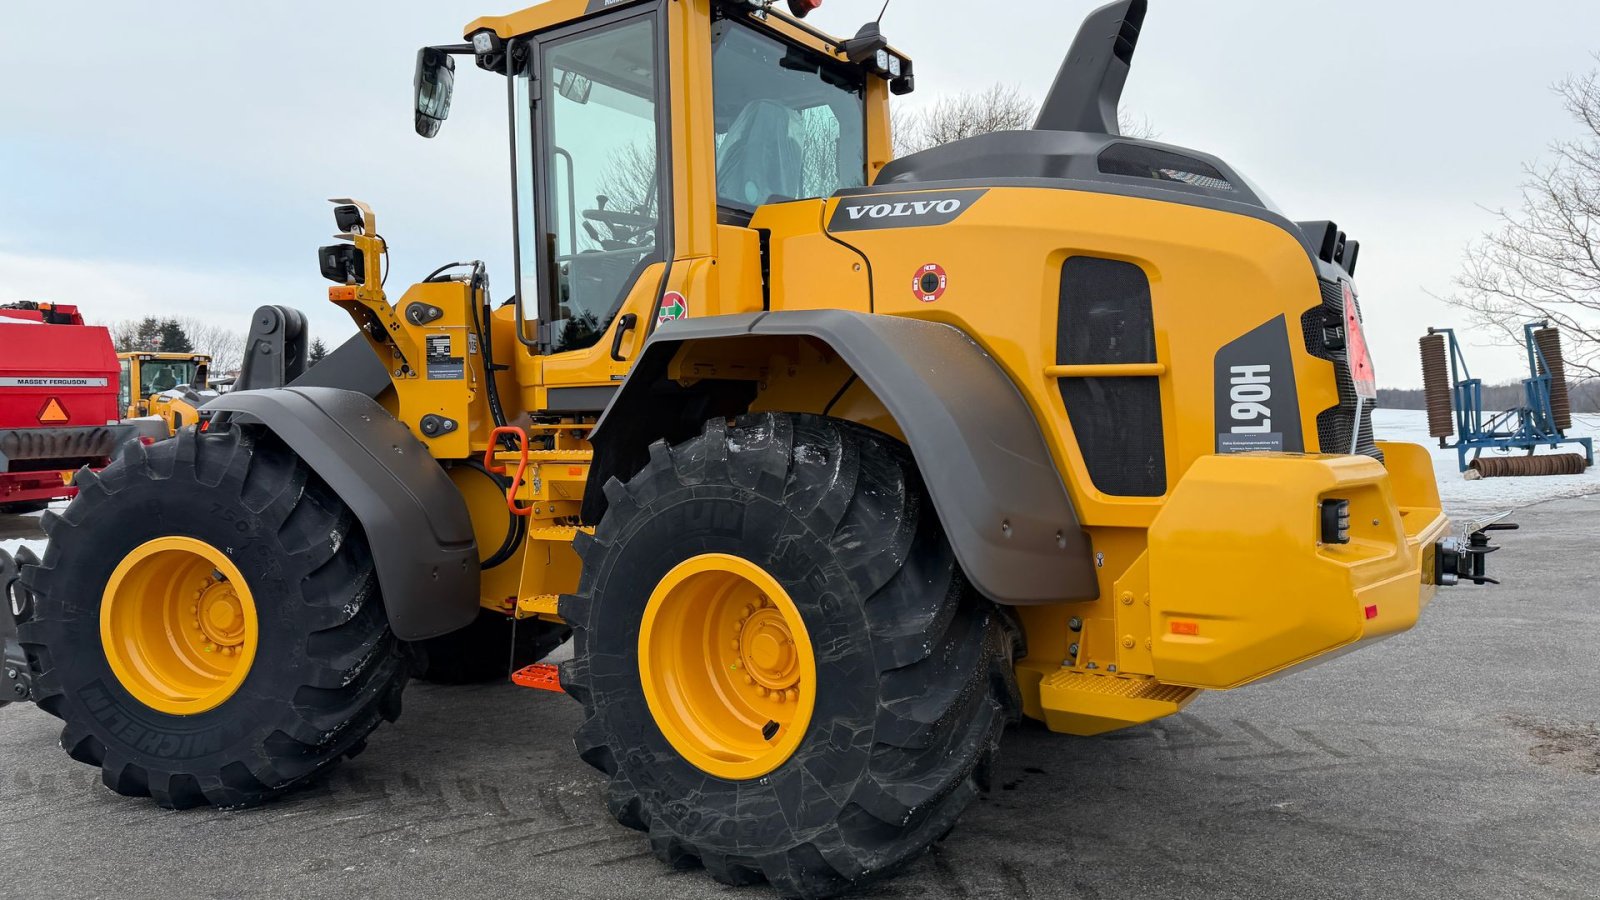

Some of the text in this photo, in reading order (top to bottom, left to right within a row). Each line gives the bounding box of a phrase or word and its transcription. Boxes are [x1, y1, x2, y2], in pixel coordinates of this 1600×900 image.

[846, 199, 961, 220] VOLVO
[1230, 364, 1271, 433] L90H
[78, 681, 223, 758] MICHELIN
